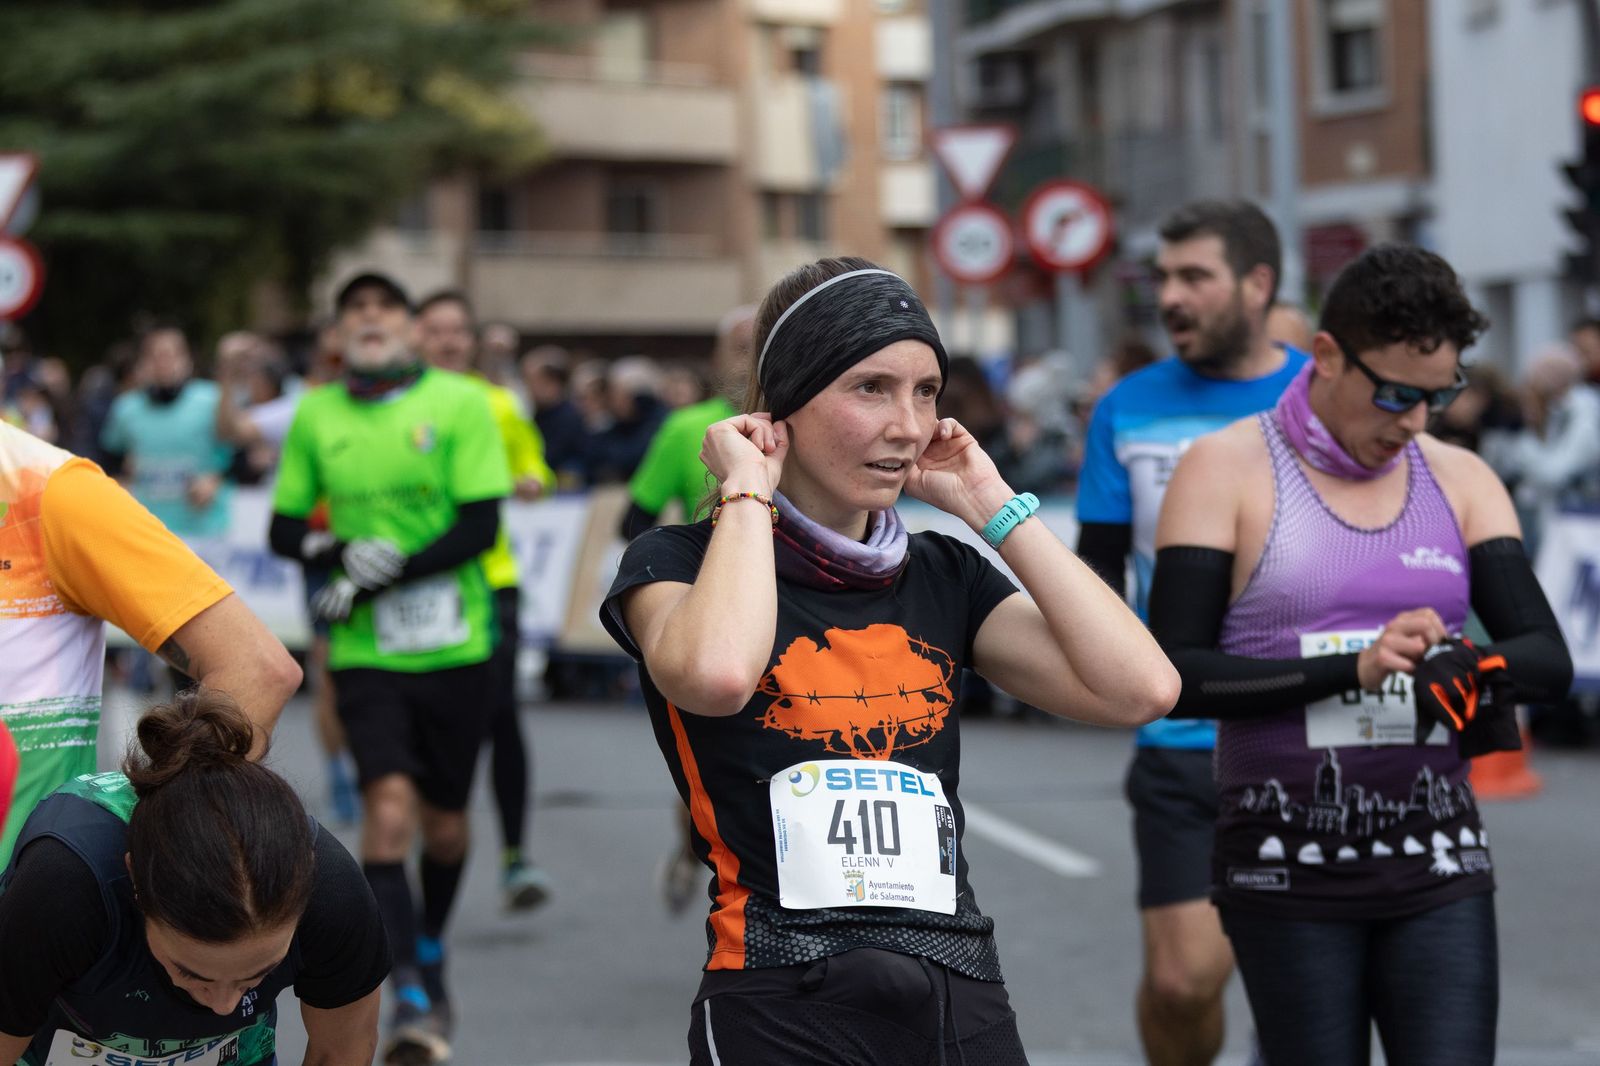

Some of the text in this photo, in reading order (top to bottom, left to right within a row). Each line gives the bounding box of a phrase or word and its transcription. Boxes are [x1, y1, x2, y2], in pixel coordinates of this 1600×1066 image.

[825, 768, 935, 797] SETEL
[827, 799, 901, 856] 410
[841, 856, 894, 868] ELENN V
[868, 880, 915, 891] Ayuntamiento
[869, 892, 915, 903] de Salamanca
